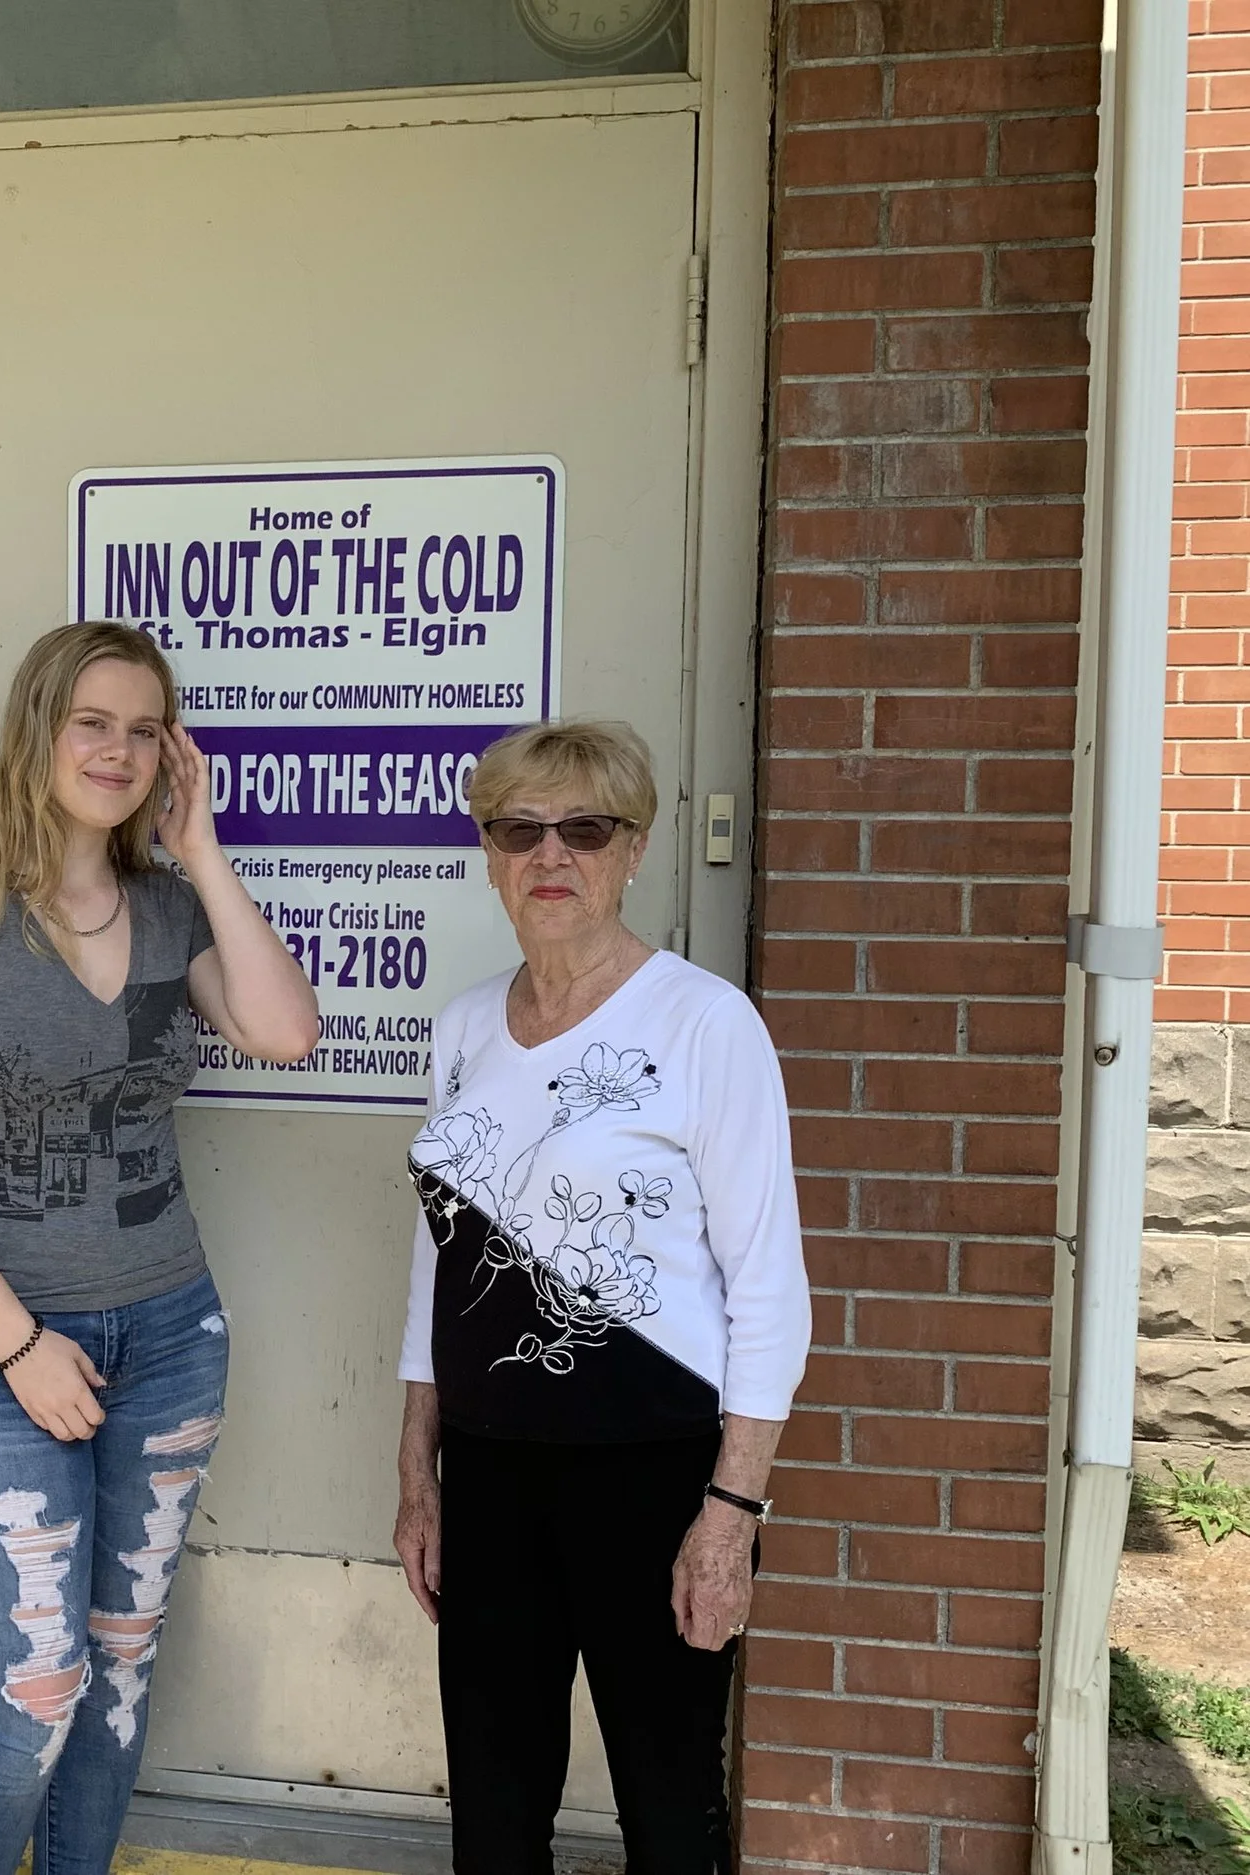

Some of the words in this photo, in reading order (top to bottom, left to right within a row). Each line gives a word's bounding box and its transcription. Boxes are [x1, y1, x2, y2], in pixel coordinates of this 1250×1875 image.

[569, 12, 581, 32] 7
[593, 14, 606, 34] 6
[619, 4, 630, 24] 5
[250, 507, 333, 531] Home
[341, 503, 371, 529] of
[104, 543, 171, 618] INN
[181, 540, 262, 618] OUT
[270, 538, 322, 617] OF
[332, 537, 407, 614] THE
[417, 534, 524, 615] COLD
[195, 617, 350, 649] Thomas
[360, 632, 372, 640] -
[383, 616, 487, 656] Elgin
[251, 685, 276, 710] for
[279, 691, 308, 710] our
[312, 685, 424, 710] COMMUNITY
[428, 683, 525, 709] HOMELESS
[239, 753, 302, 815] FOR
[308, 753, 371, 814] THE
[377, 753, 479, 816] SEASO
[231, 858, 274, 877] Crisis
[278, 858, 373, 884] Emergency
[376, 860, 432, 884] please
[436, 860, 466, 880] call
[254, 901, 274, 925] 4
[279, 902, 324, 928] hour
[328, 902, 379, 930] Crisis
[384, 903, 425, 930] Line
[286, 933, 427, 990] 31-2180
[318, 1014, 371, 1045] OKING,
[374, 1016, 432, 1042] ALCOH
[198, 1044, 228, 1069] UGS
[333, 1048, 419, 1076] BEHAVIOR
